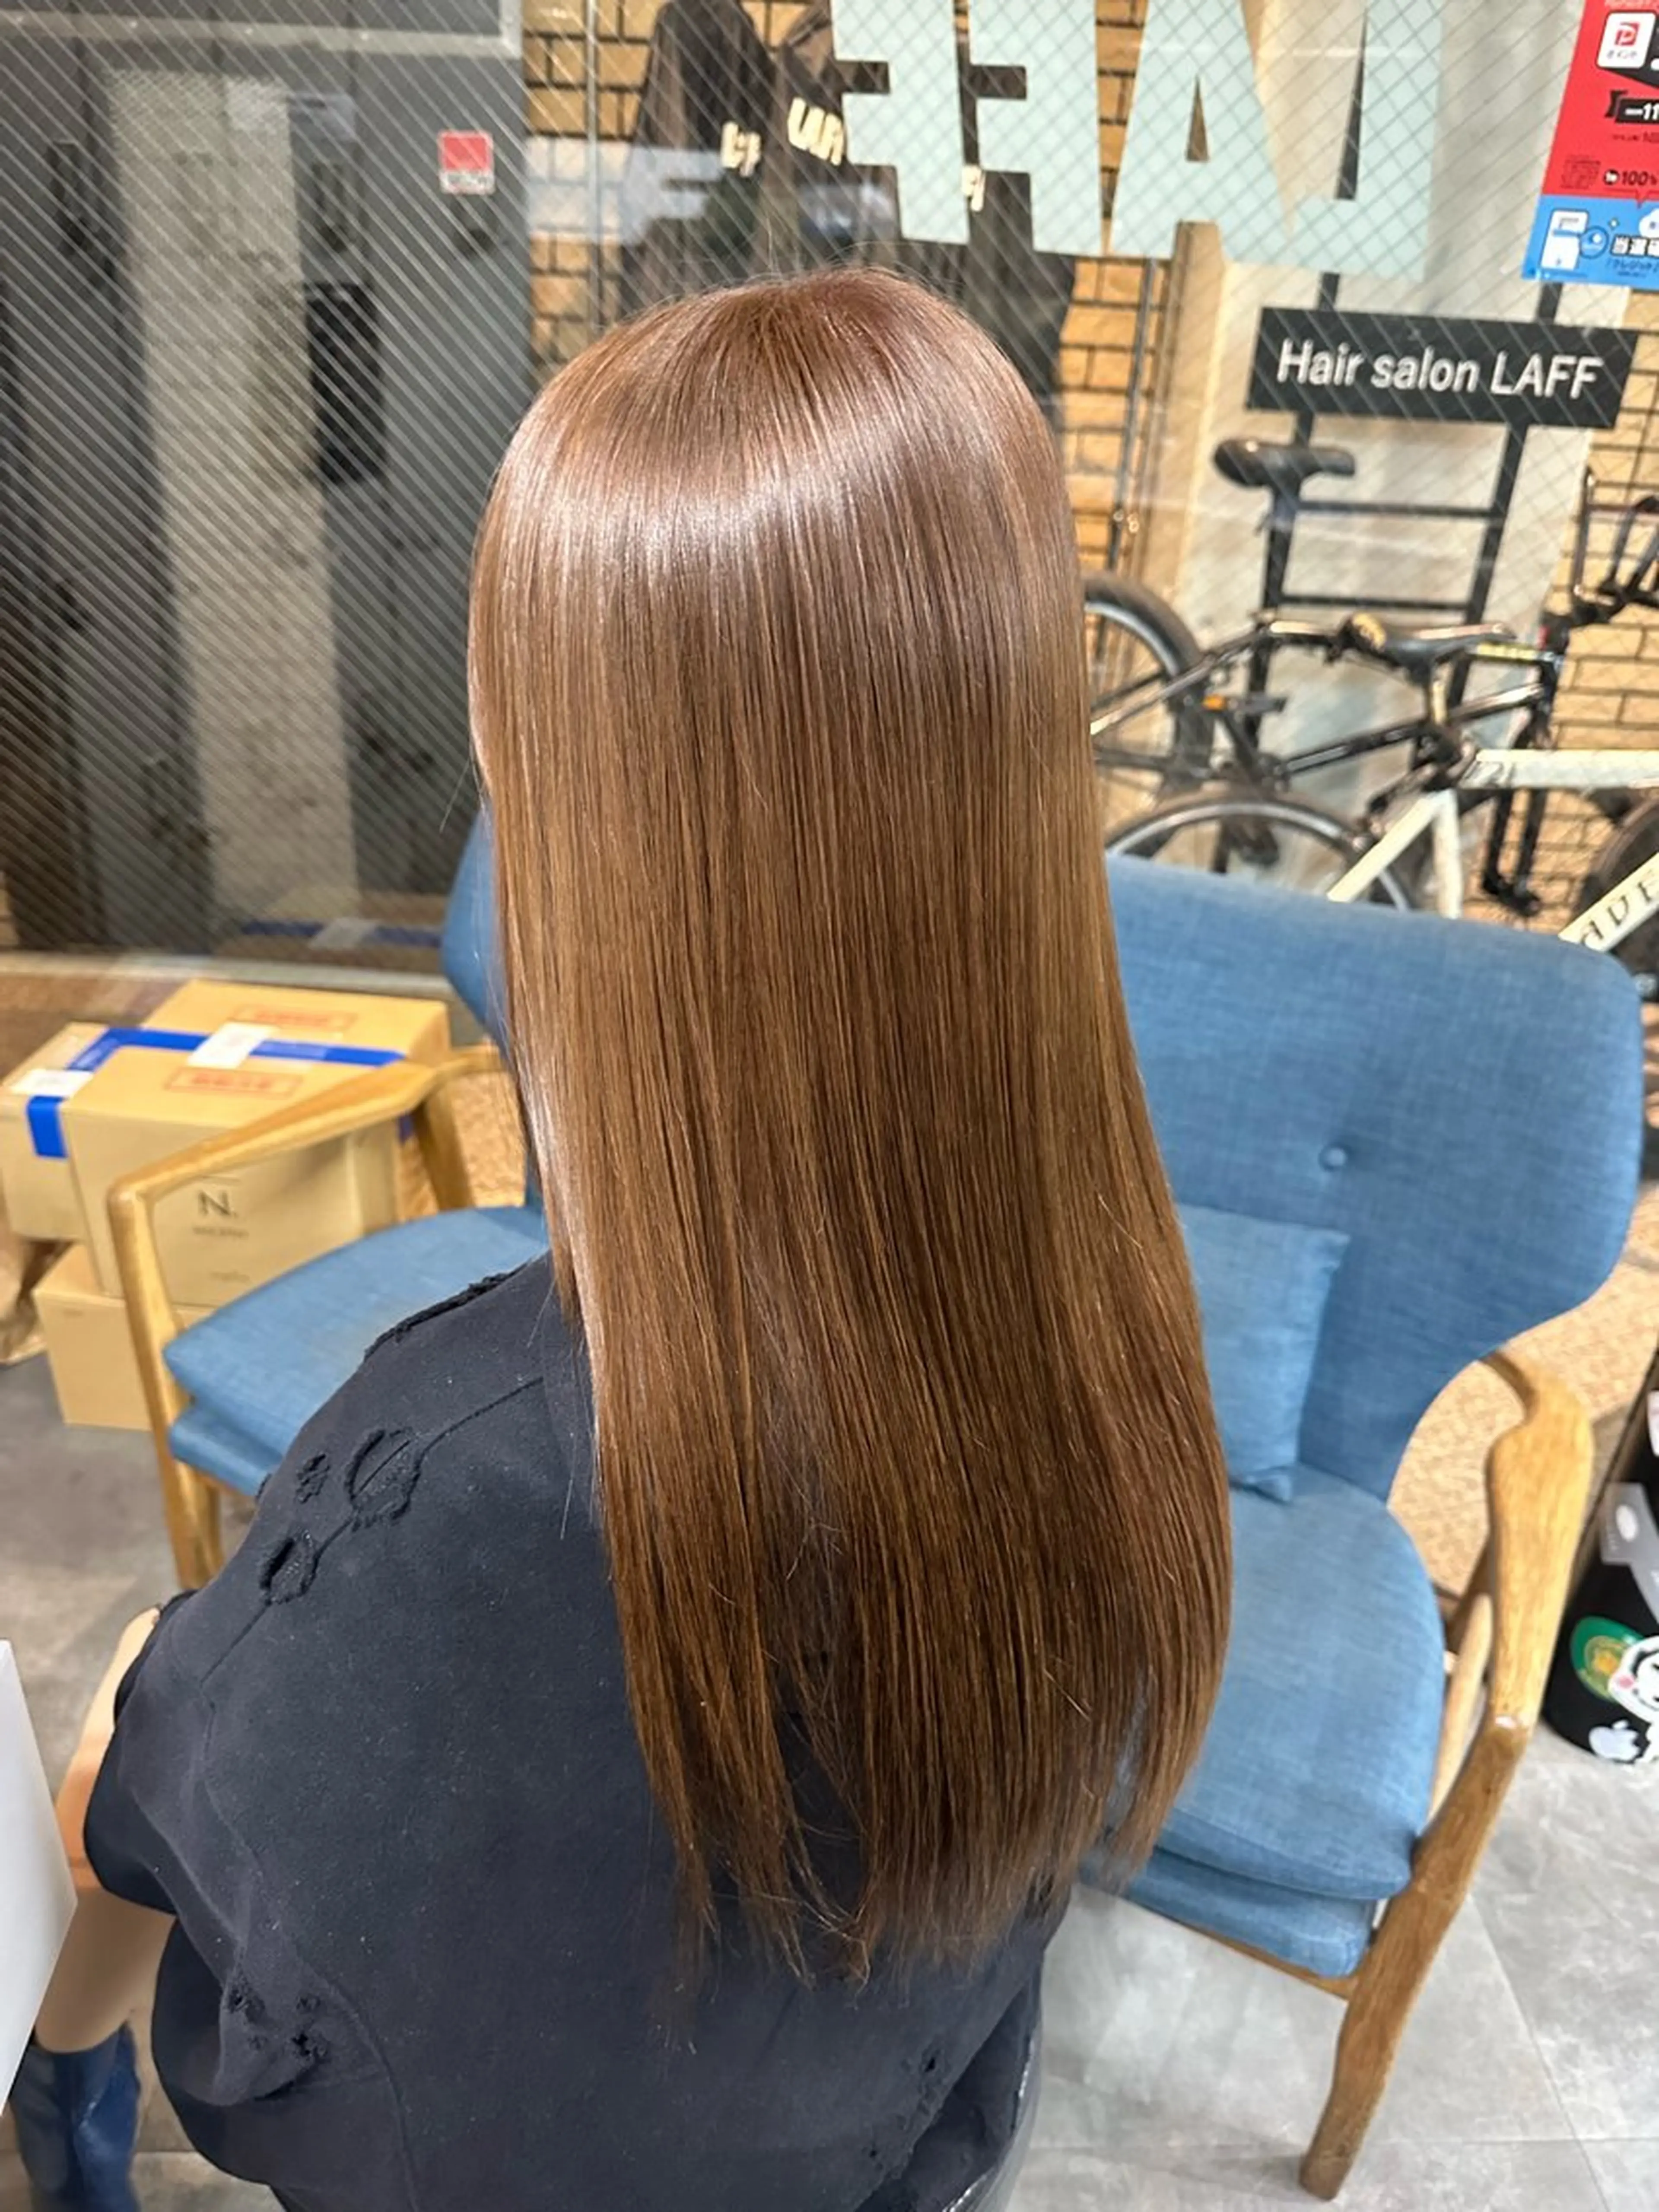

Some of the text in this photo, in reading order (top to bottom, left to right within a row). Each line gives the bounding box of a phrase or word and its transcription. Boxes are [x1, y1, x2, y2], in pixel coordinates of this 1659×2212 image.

[1277, 337, 1605, 399] Hair salon LAFF
